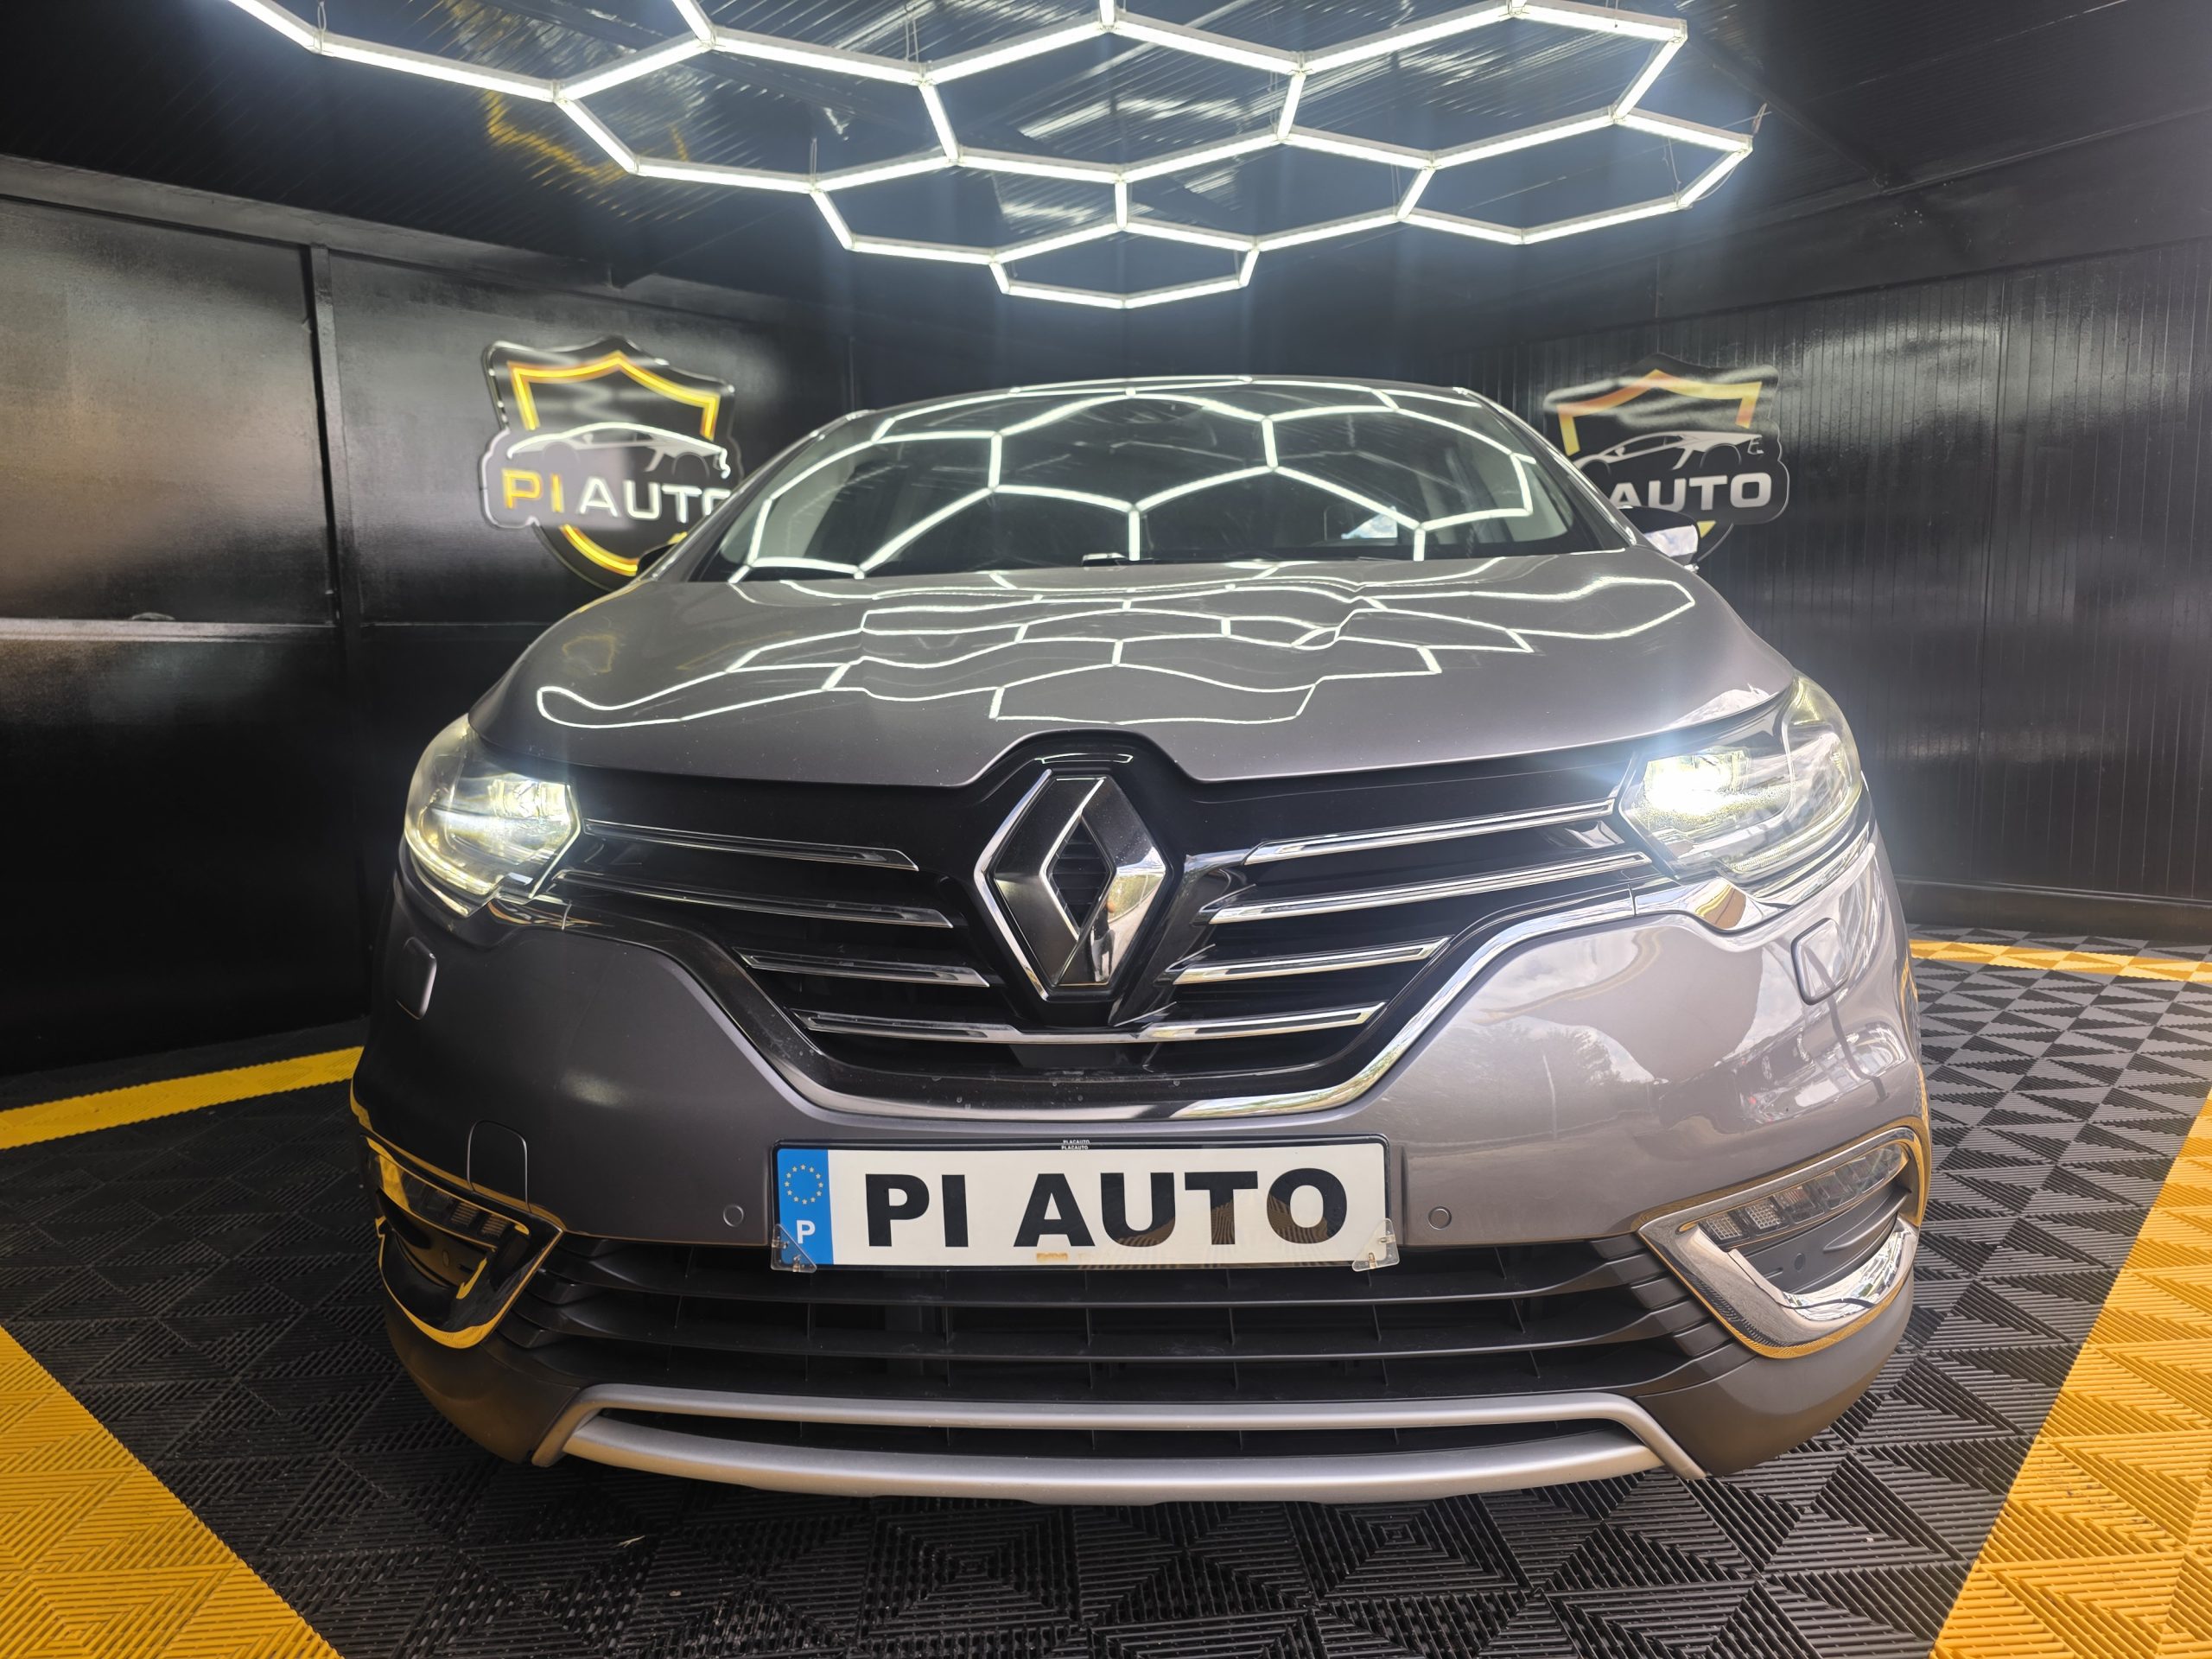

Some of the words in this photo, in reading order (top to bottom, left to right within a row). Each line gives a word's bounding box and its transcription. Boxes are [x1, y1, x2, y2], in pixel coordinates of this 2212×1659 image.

[501, 467, 565, 513] PI
[1609, 473, 1771, 513] AUTO
[865, 1173, 969, 1247] PI
[1014, 1167, 1348, 1247] AUTO
[796, 1219, 816, 1244] P
